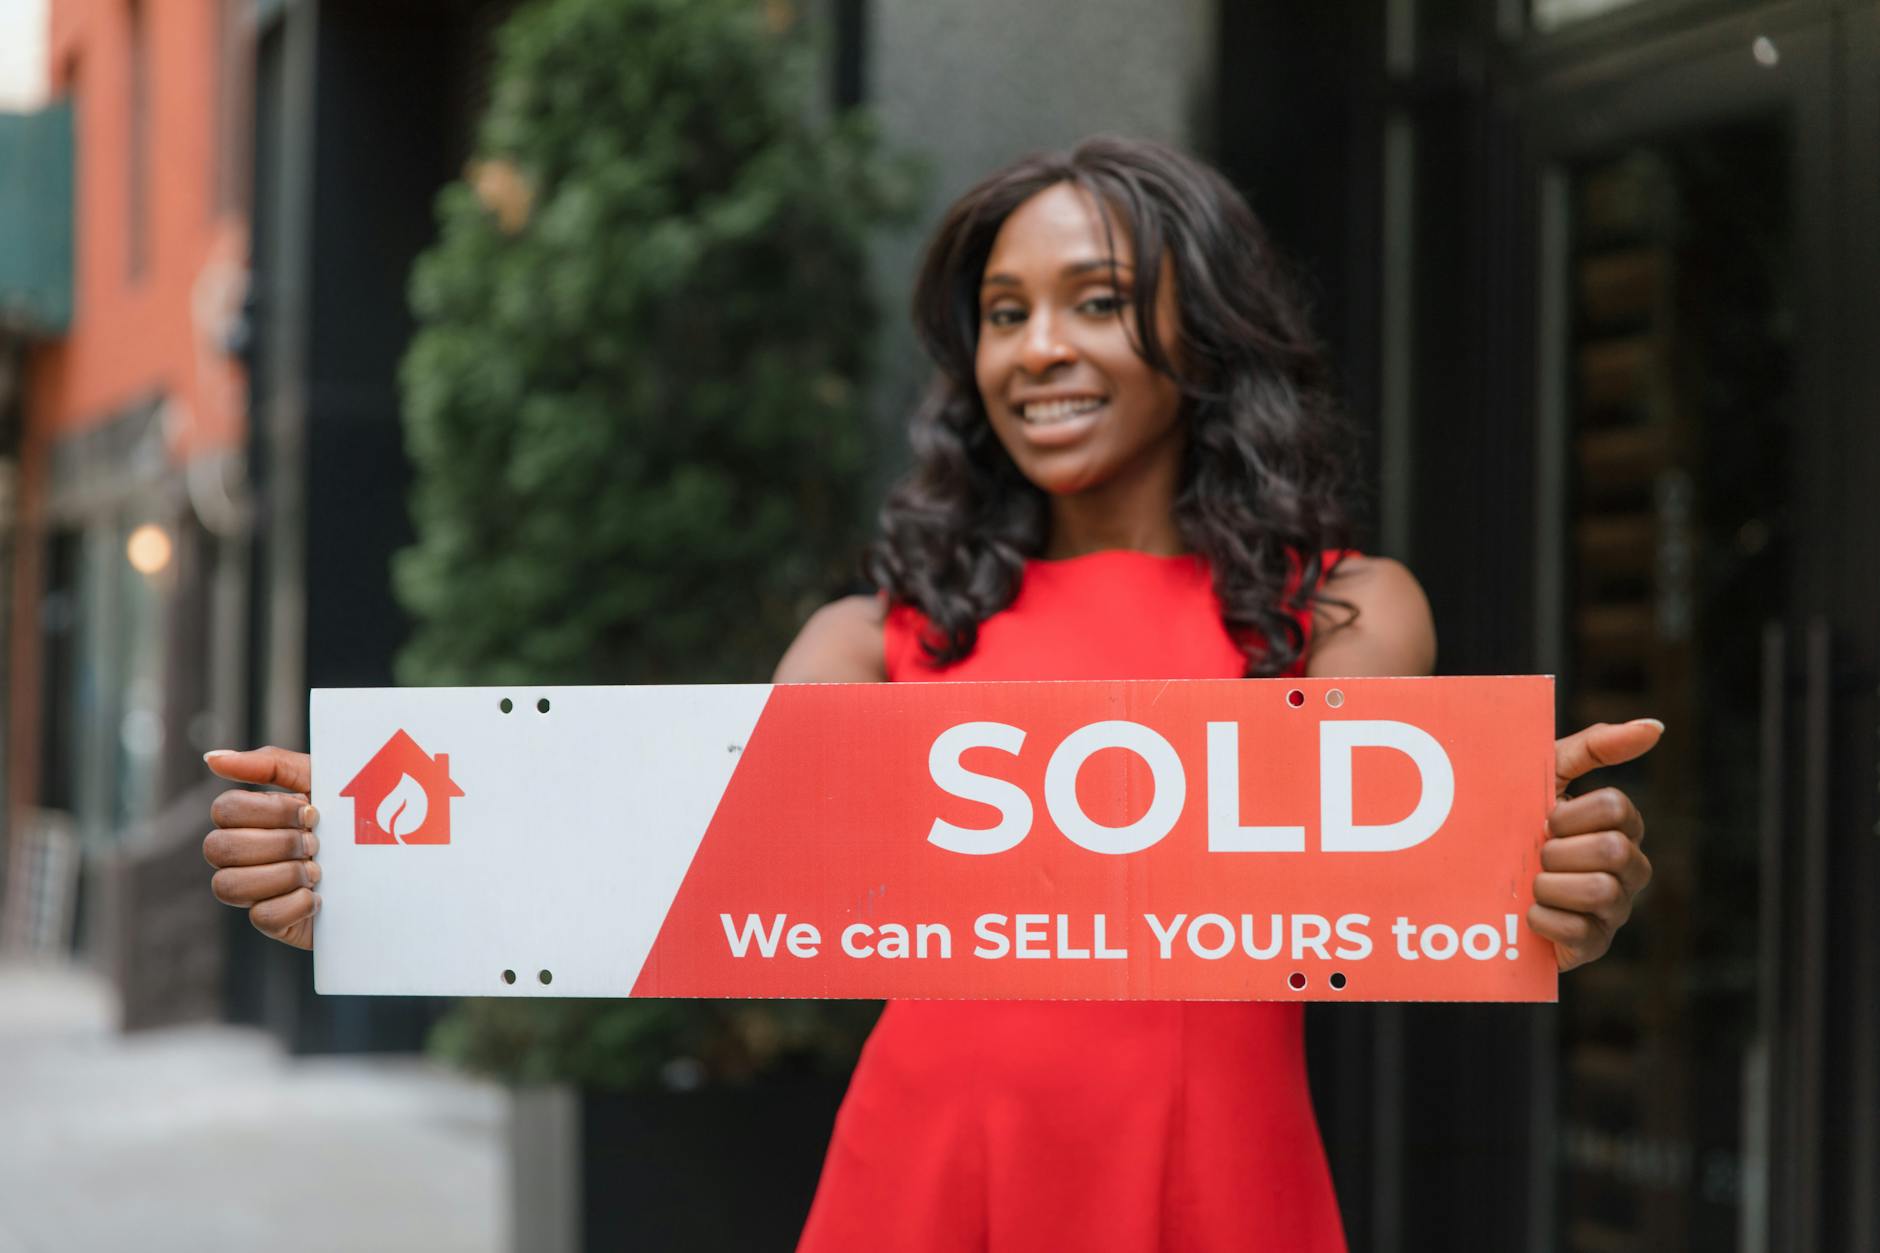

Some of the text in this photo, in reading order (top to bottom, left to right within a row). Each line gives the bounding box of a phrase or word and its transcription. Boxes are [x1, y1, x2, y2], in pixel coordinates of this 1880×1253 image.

[927, 720, 1455, 855] SOLD
[720, 913, 1519, 961] We can SELL YOURS too!
